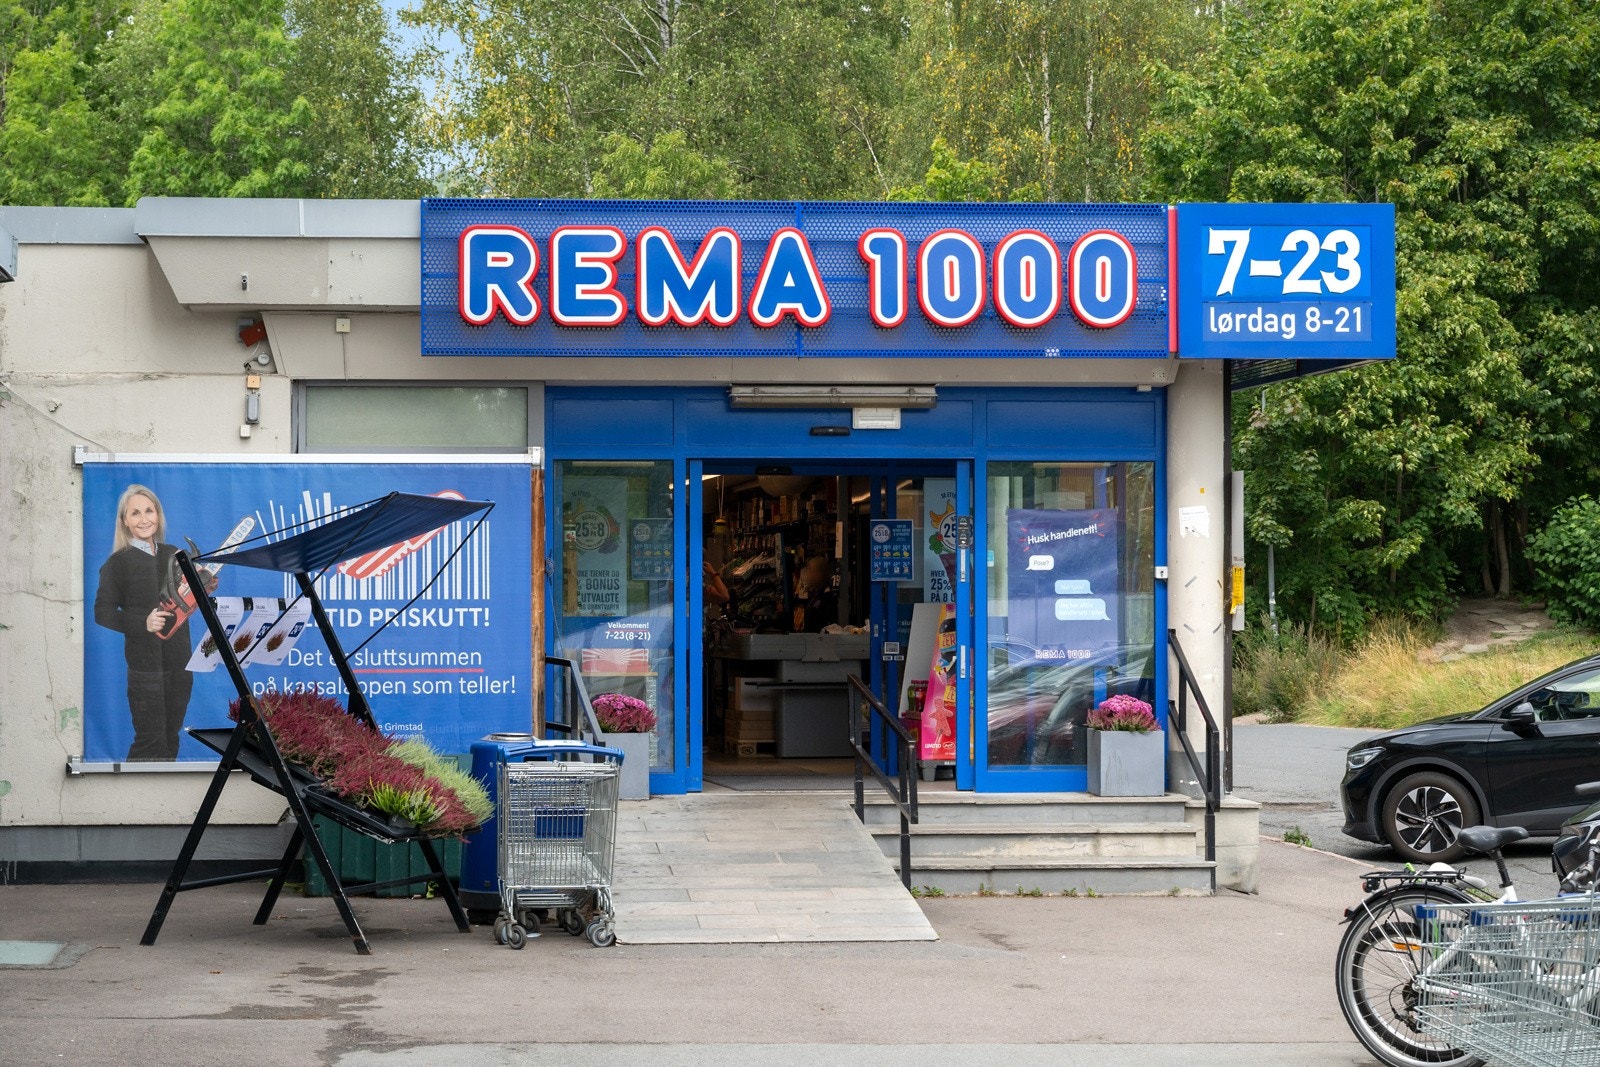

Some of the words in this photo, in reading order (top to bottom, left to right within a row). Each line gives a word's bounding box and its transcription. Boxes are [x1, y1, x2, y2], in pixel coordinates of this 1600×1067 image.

[1208, 227, 1361, 298] 7-23
[459, 224, 830, 327] REMA
[859, 227, 1138, 328] 1000
[1210, 307, 1296, 339] lørdag
[1305, 307, 1362, 333] 8-21
[1027, 532, 1050, 544] Husk
[1050, 523, 1098, 541] handlenett!
[590, 570, 610, 578] TJENER
[930, 570, 945, 578] HVER
[585, 578, 620, 591] BONUS
[930, 578, 951, 591] 25%
[581, 593, 620, 603] UTVALGTE
[930, 590, 941, 603] PÅ
[942, 592, 949, 603] 8
[369, 607, 490, 628] PRISKUTT!
[288, 648, 323, 667] Det
[354, 648, 482, 667] sluttsummen
[1035, 649, 1066, 659] REMA
[1066, 649, 1091, 659] 1000
[253, 676, 276, 698] på
[412, 680, 453, 695] som
[458, 676, 516, 695] teller!
[384, 722, 423, 731] Grimstad
